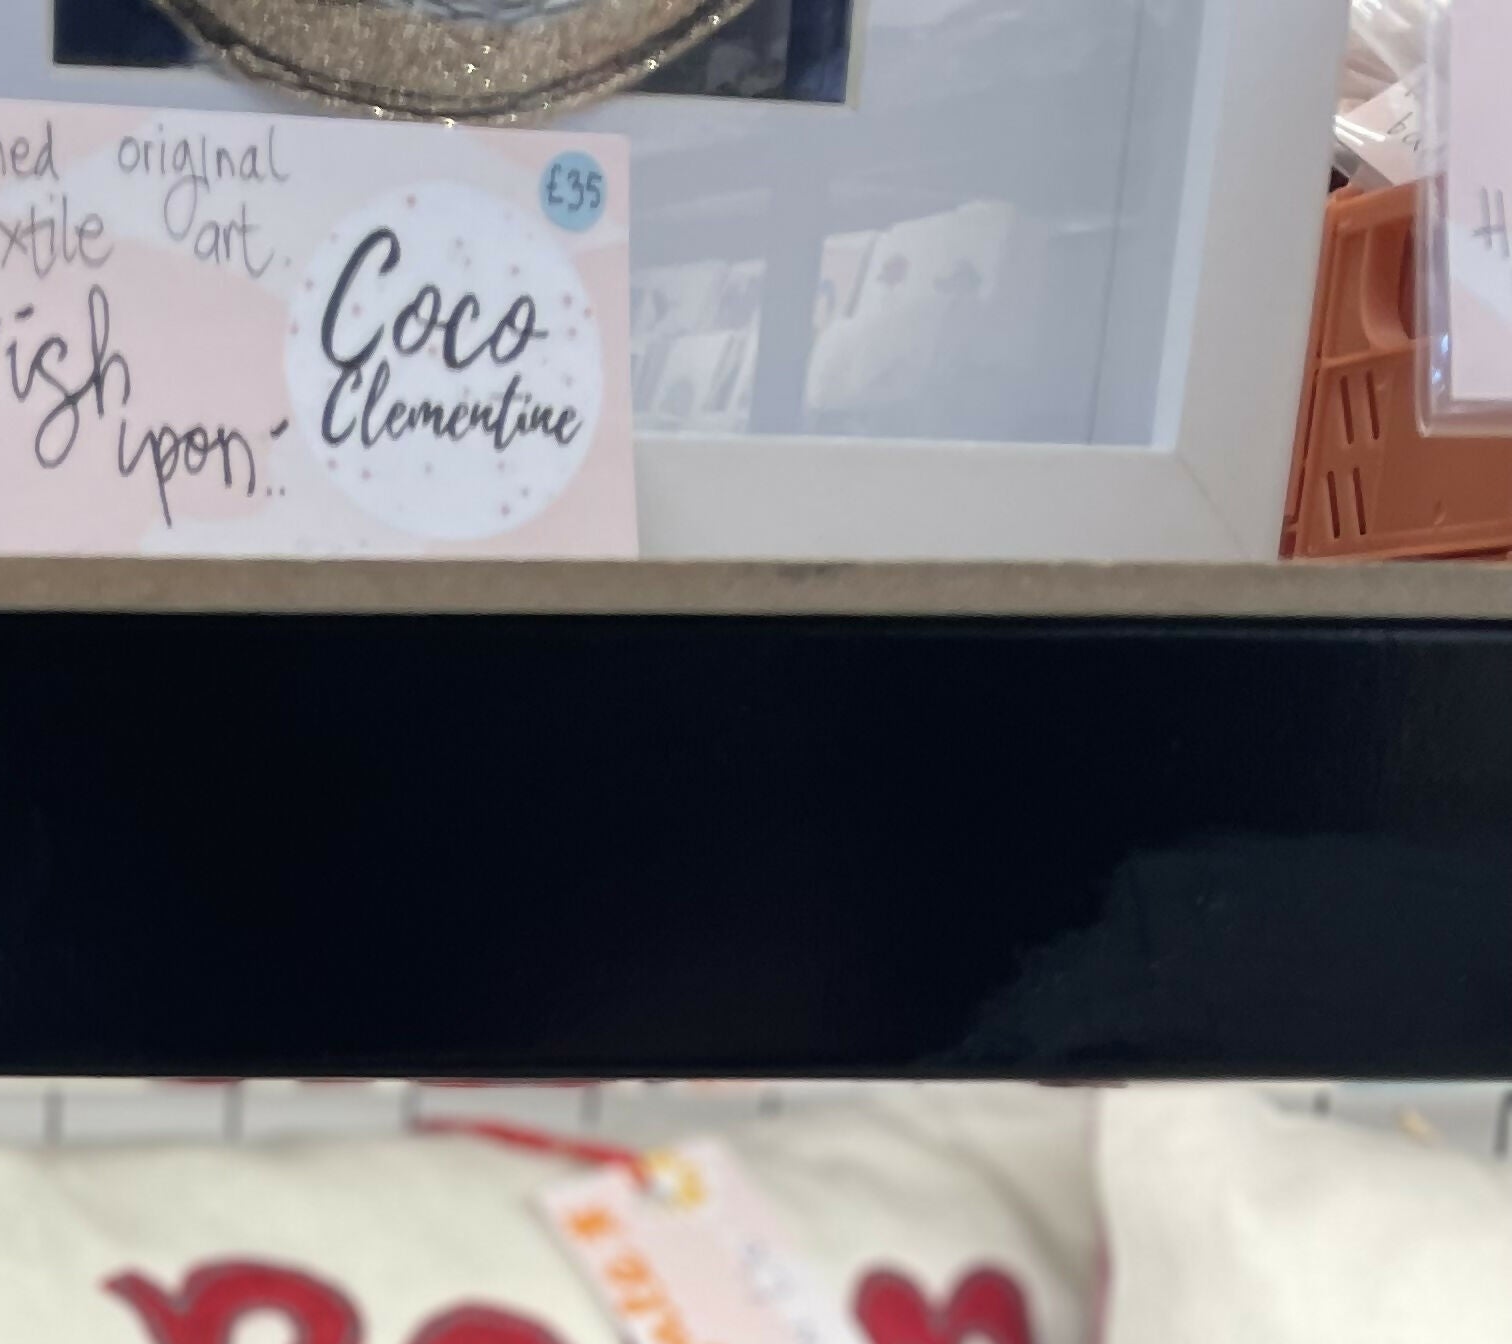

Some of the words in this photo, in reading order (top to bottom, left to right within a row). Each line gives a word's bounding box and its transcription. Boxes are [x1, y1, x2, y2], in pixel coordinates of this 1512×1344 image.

[117, 123, 289, 241] original
[545, 163, 603, 212] £35
[320, 224, 550, 370] Coco
[321, 359, 583, 453] Clementine
